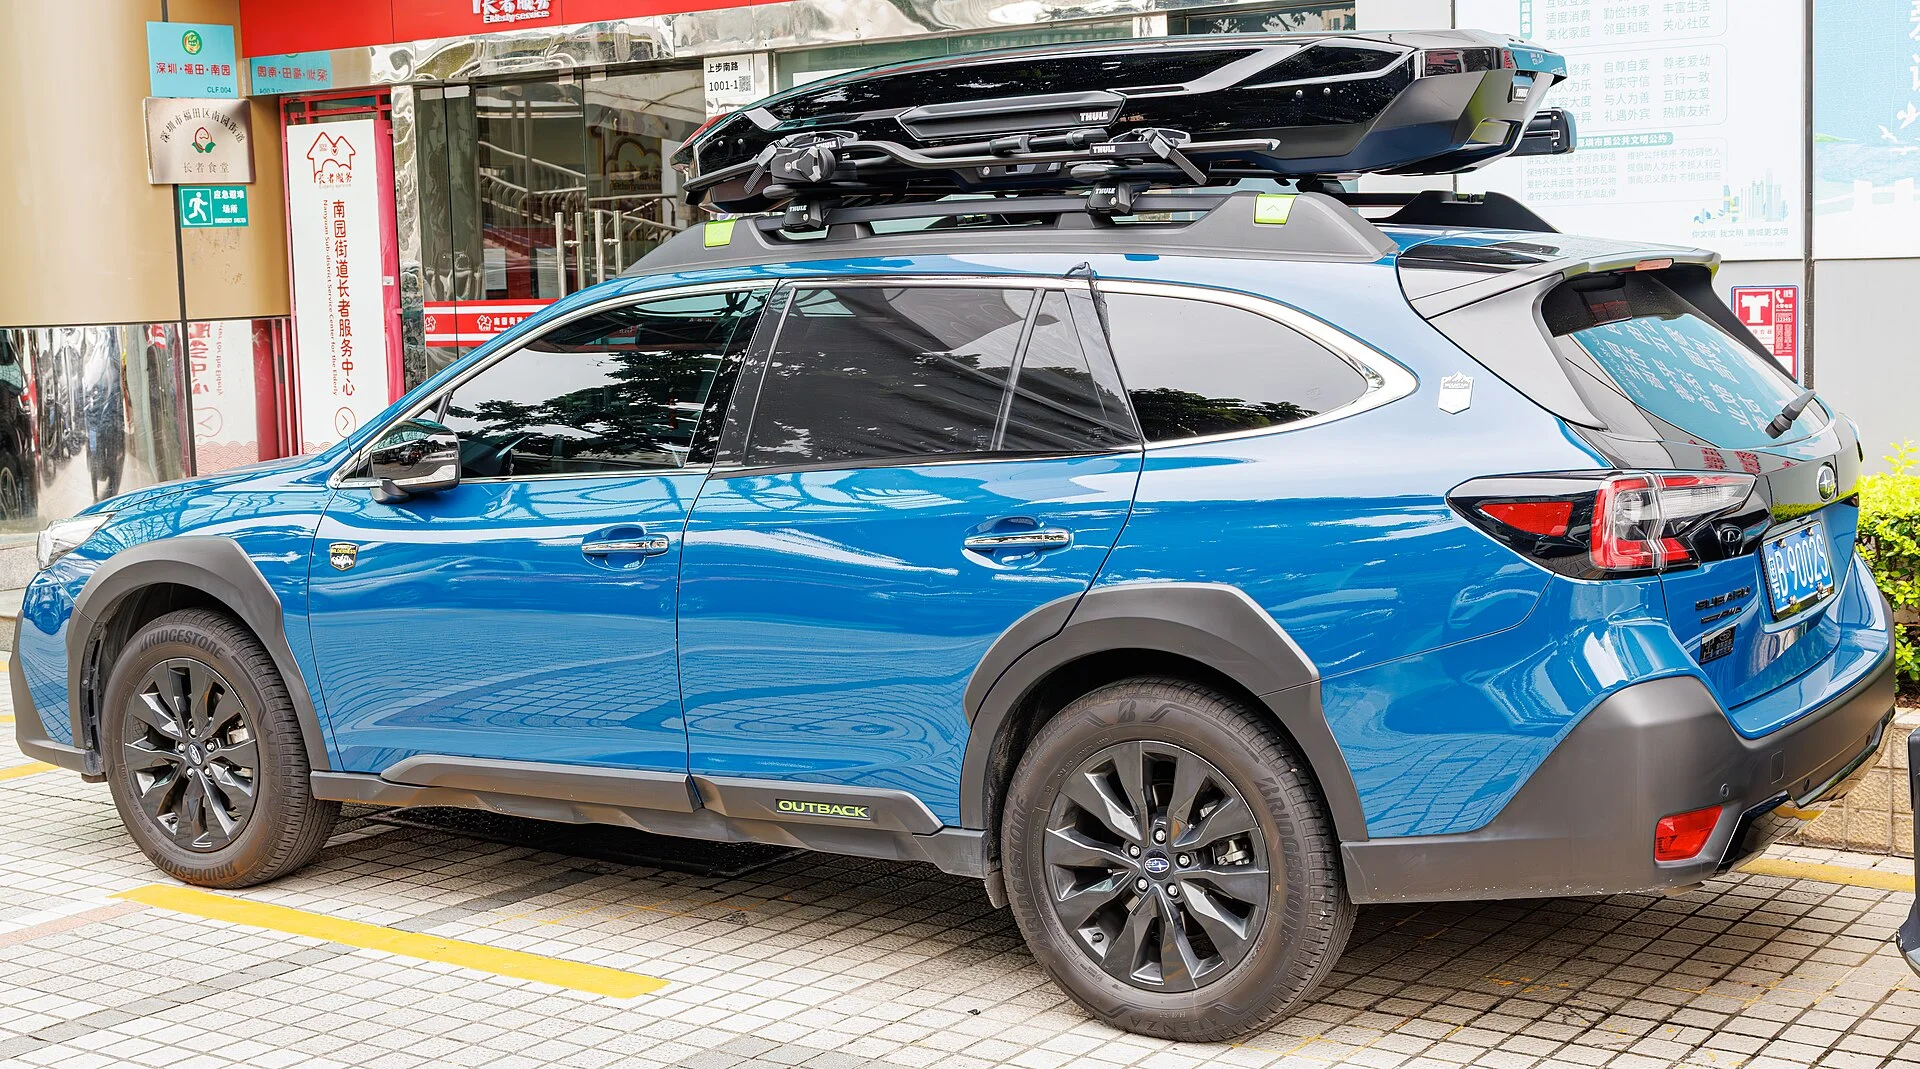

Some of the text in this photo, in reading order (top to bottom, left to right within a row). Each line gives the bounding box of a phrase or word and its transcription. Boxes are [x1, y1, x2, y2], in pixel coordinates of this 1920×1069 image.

[1546, 16, 1711, 41] 美化家庭 邻里和睦 关心社区
[707, 61, 739, 73] 上步南路
[1604, 59, 1649, 74] 自尊自爱
[1663, 54, 1711, 69] 尊老爱幼
[709, 79, 739, 92] 1001-1
[1604, 74, 1650, 90] 诚实守信
[1663, 71, 1711, 87] 言行一致
[1663, 88, 1711, 103] 互助友爱
[1080, 111, 1109, 121] THULE
[1663, 104, 1711, 120] 热情友好
[1093, 145, 1116, 154] THULE
[183, 162, 230, 174] 长者食堂
[1095, 187, 1116, 195] THULE
[789, 204, 808, 213] THULE
[332, 199, 356, 397] 南园街道长者服务中心
[1695, 586, 1750, 610] SUBARU
[141, 629, 225, 660] BRIDGESTONE
[778, 800, 869, 818] OUTBACK
